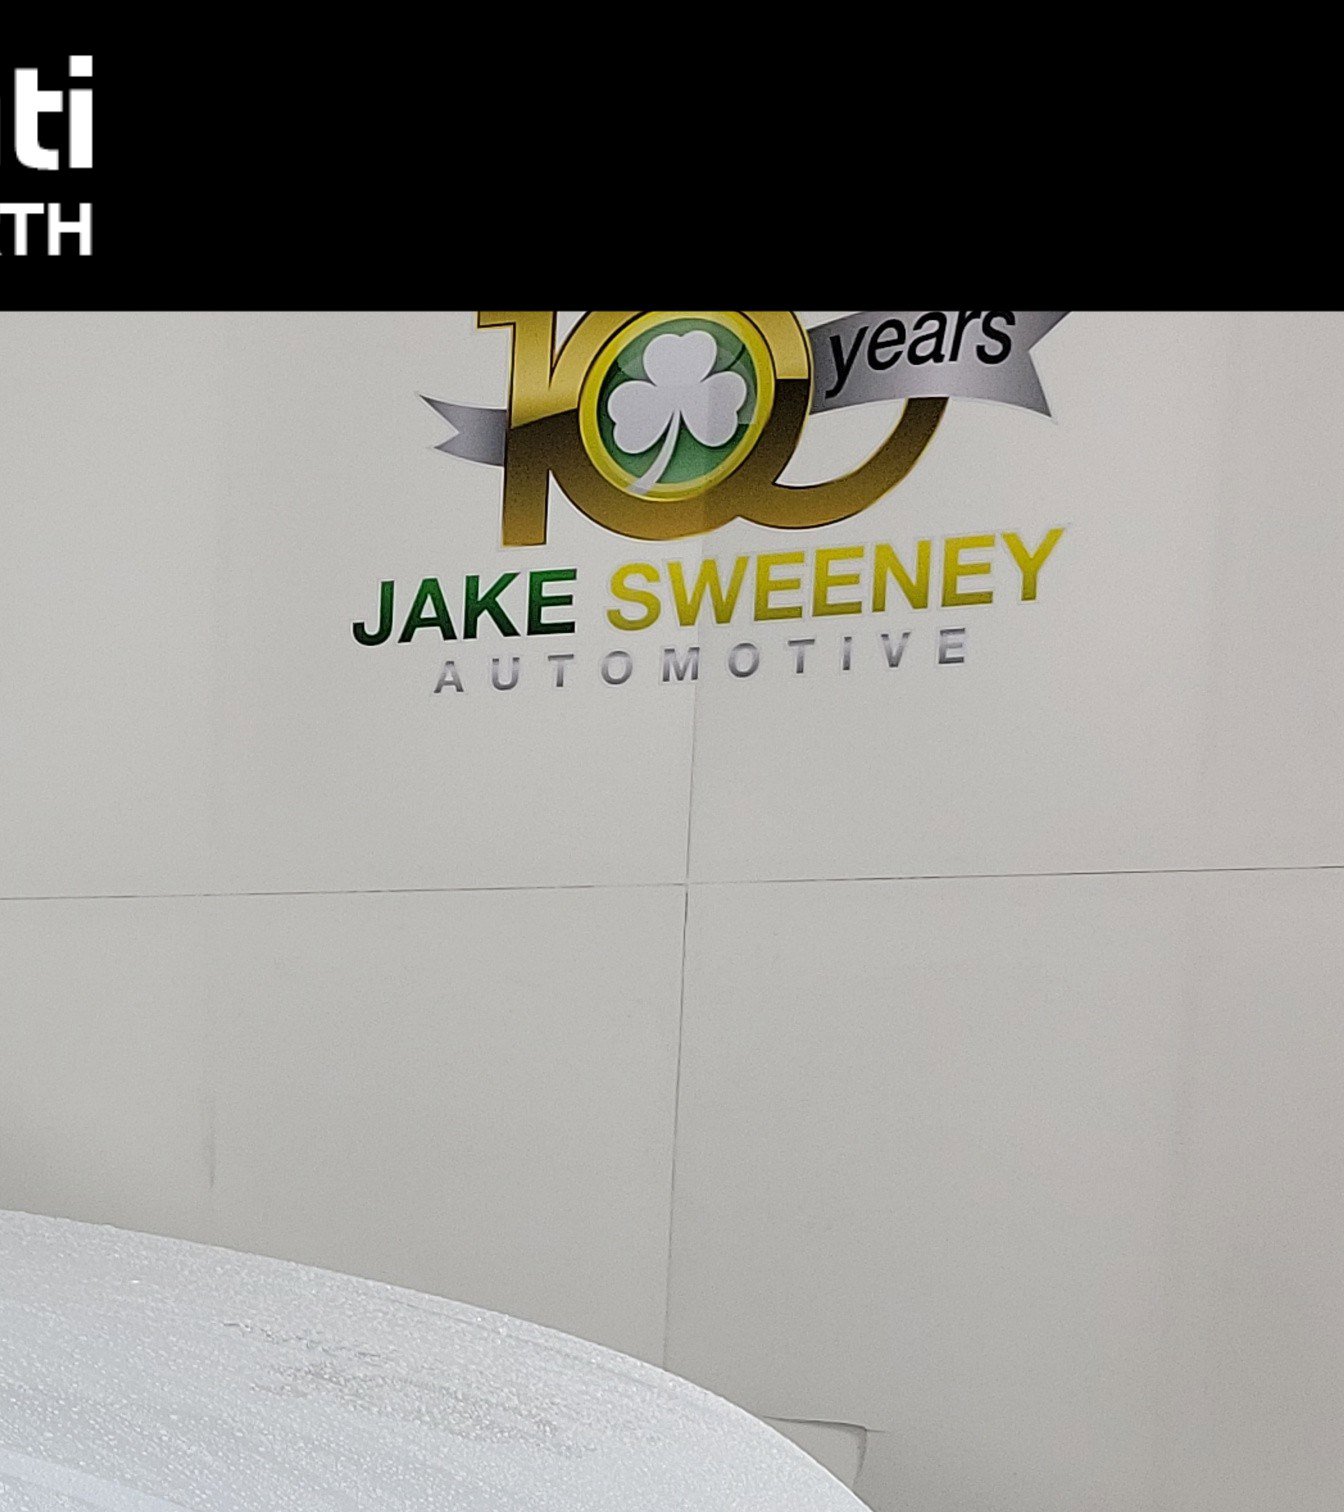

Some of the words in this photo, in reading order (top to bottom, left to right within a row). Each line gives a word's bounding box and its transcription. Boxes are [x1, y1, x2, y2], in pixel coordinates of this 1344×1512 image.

[824, 311, 1017, 397] years
[351, 568, 578, 647] JAKE
[605, 528, 1065, 632] SWEENEY
[432, 628, 967, 696] AUTOMOTIVE
